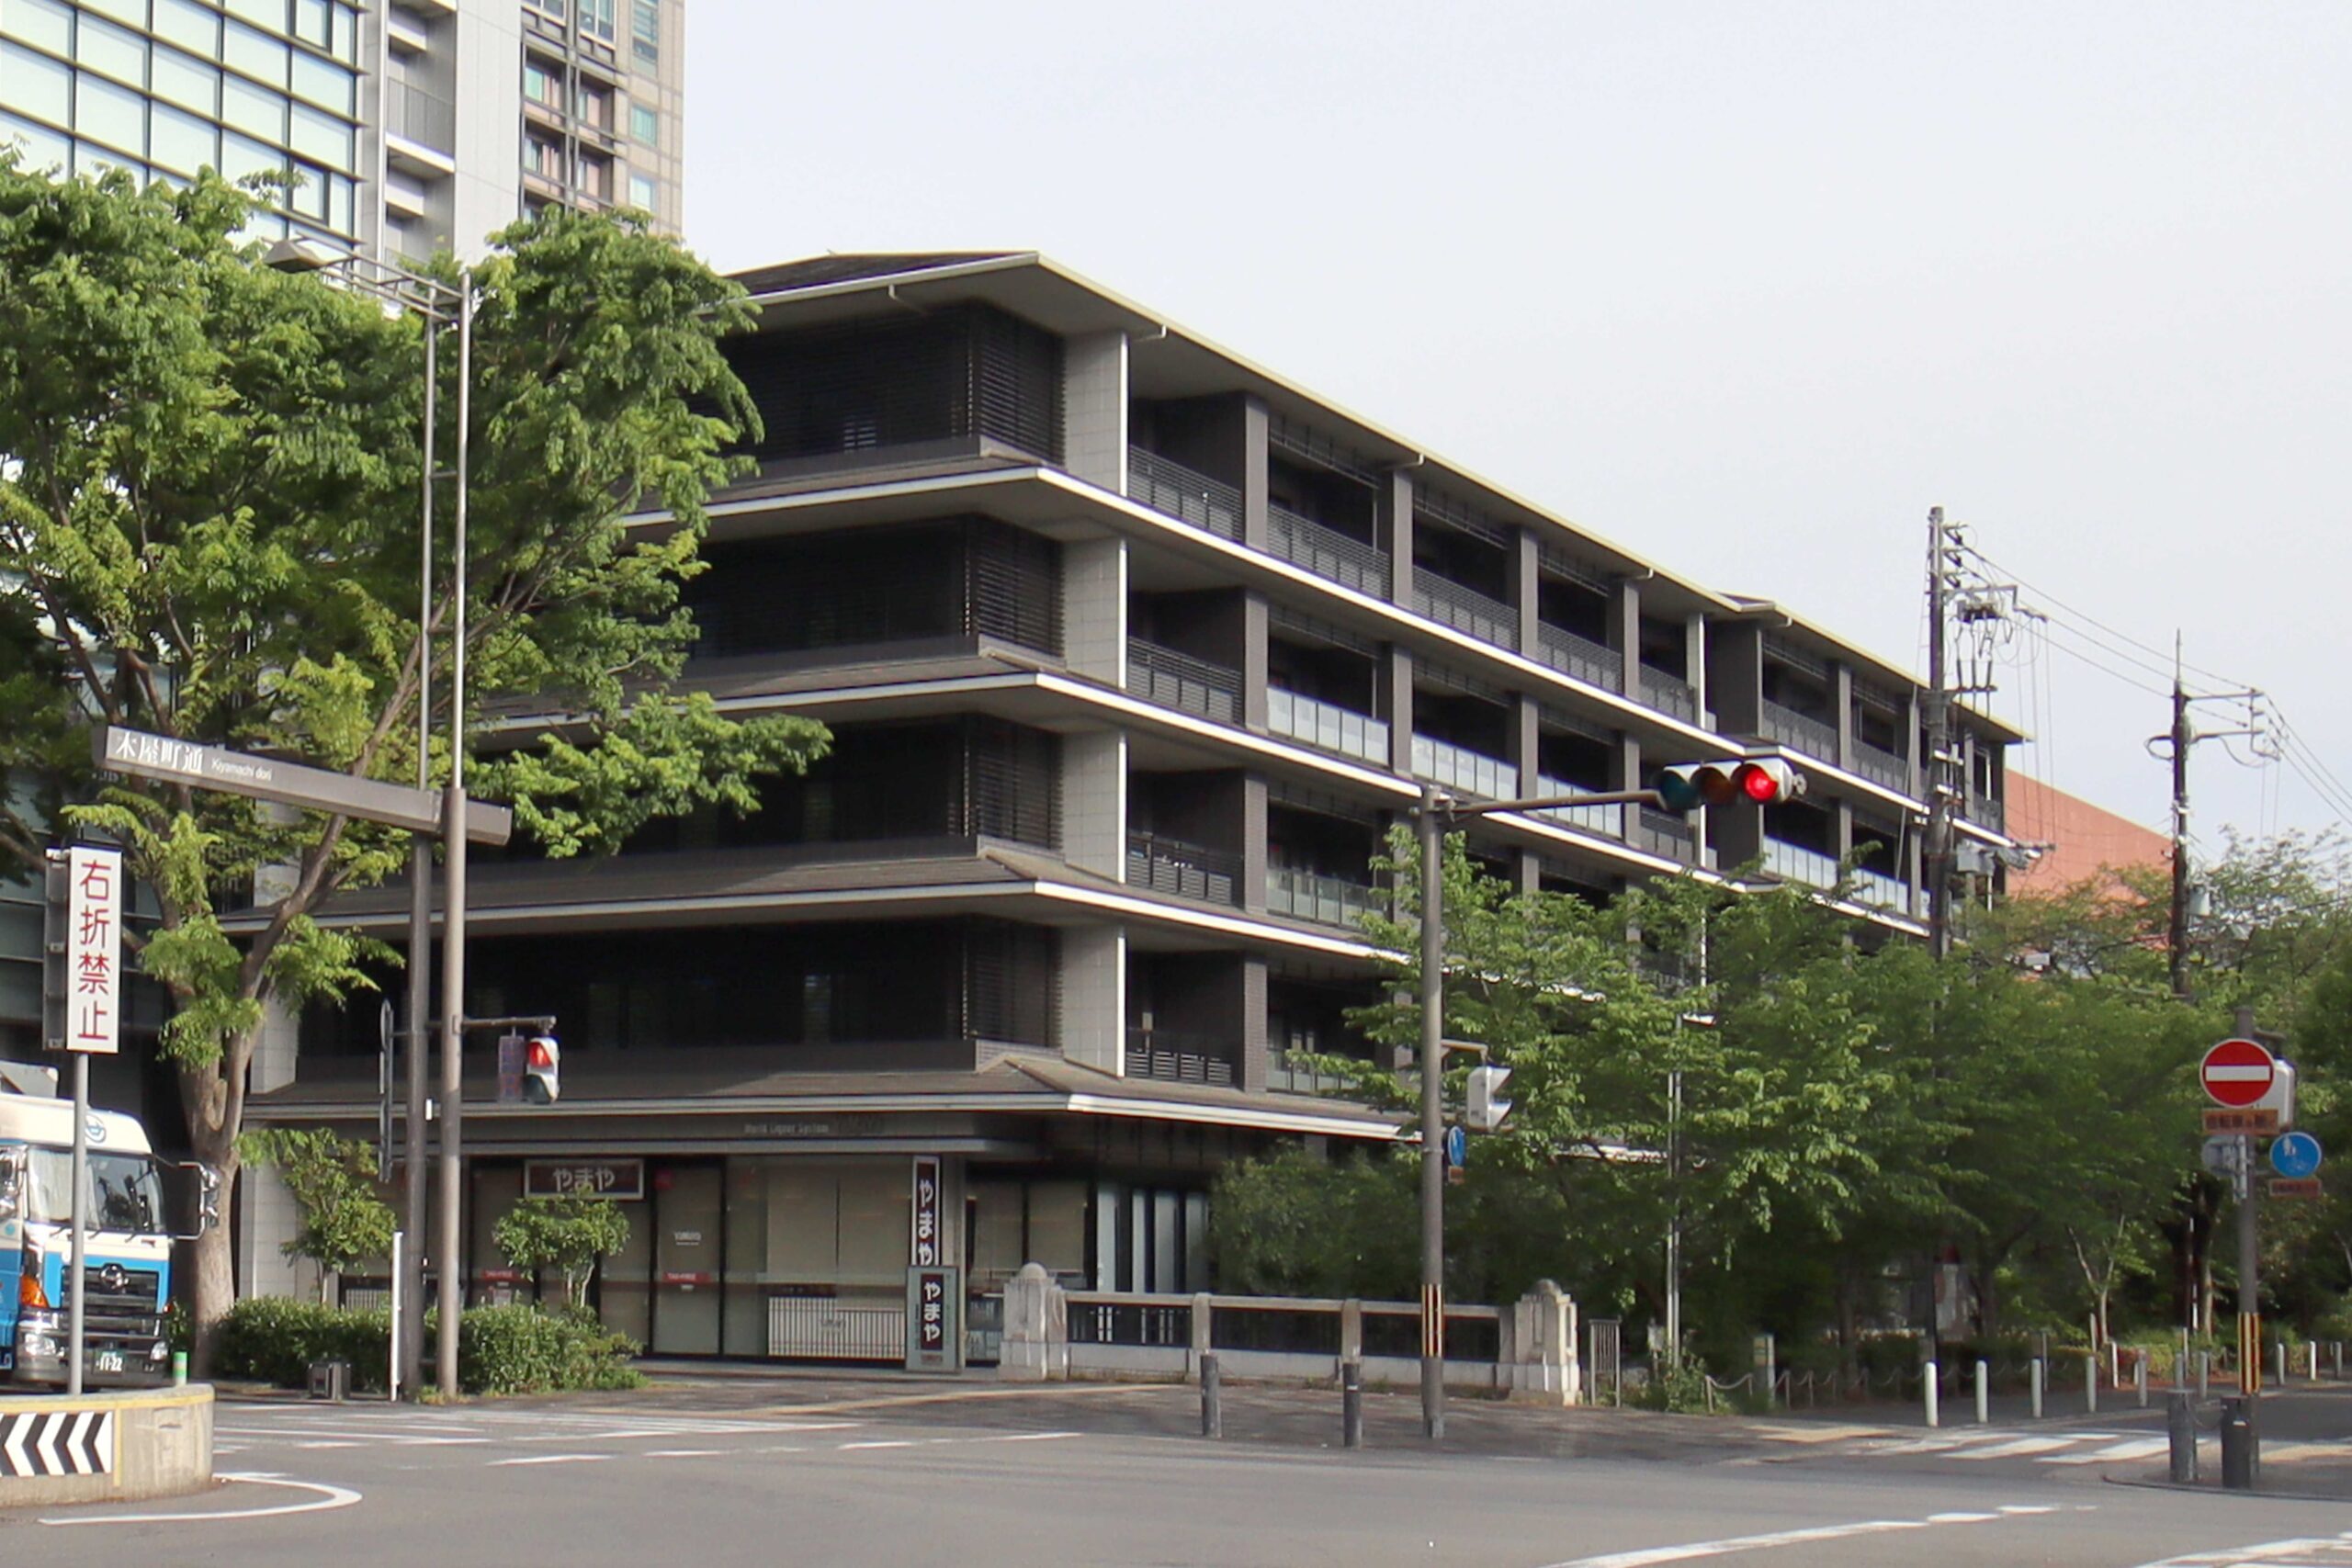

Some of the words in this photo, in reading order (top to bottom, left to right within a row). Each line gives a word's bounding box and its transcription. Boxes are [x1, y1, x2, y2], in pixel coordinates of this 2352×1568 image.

[116, 731, 203, 774] 木屋町通
[78, 860, 111, 1041] 右折禁止
[552, 1168, 616, 1192] やまや
[919, 1179, 934, 1266] やまや
[923, 1281, 942, 1342] やまや
